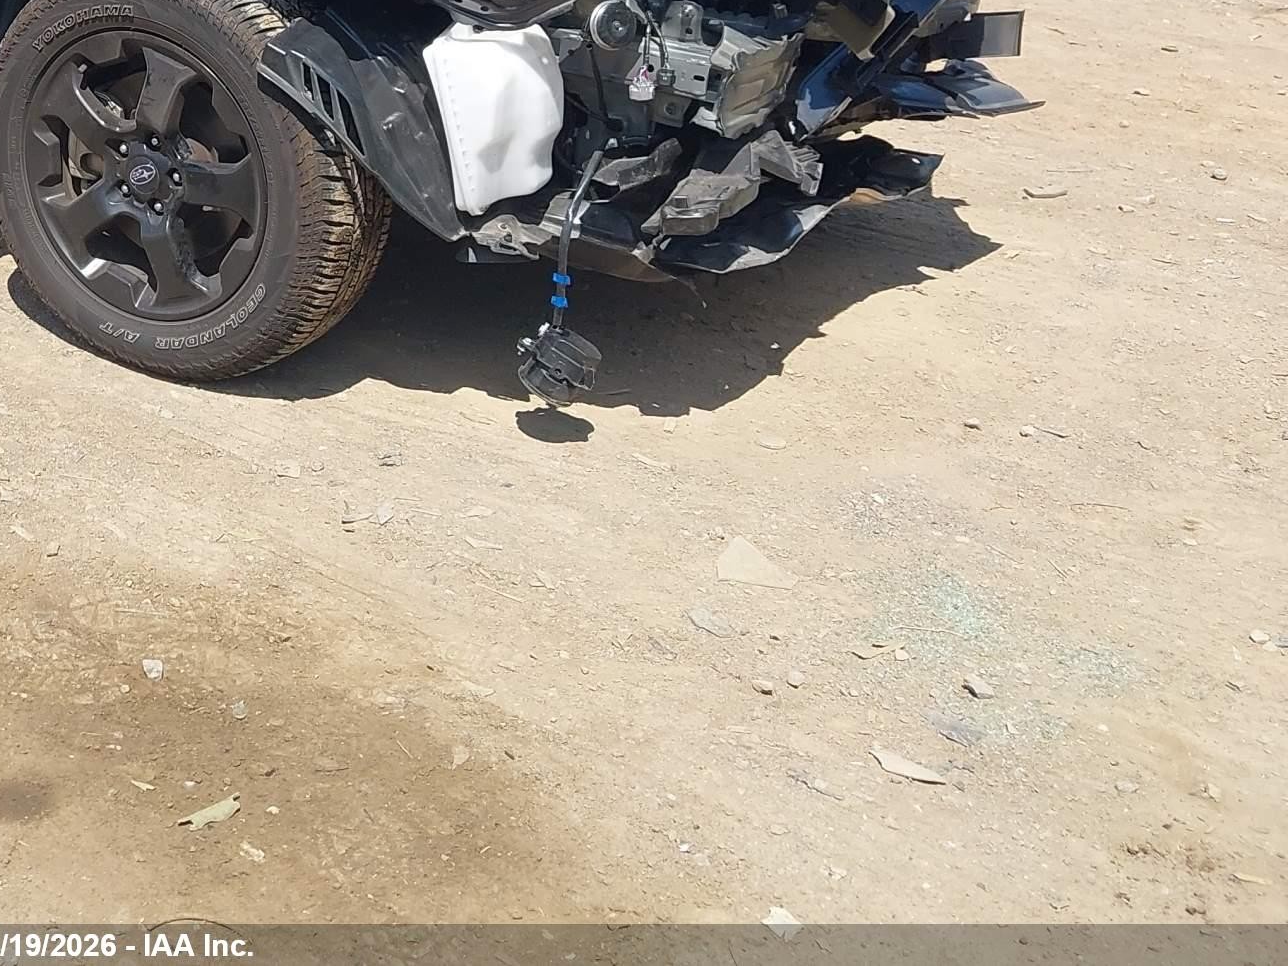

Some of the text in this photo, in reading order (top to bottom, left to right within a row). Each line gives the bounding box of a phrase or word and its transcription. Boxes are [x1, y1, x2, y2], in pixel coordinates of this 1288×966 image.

[32, 4, 135, 51] YOKOHAMA
[98, 283, 267, 350] GEOLANDAR A/T
